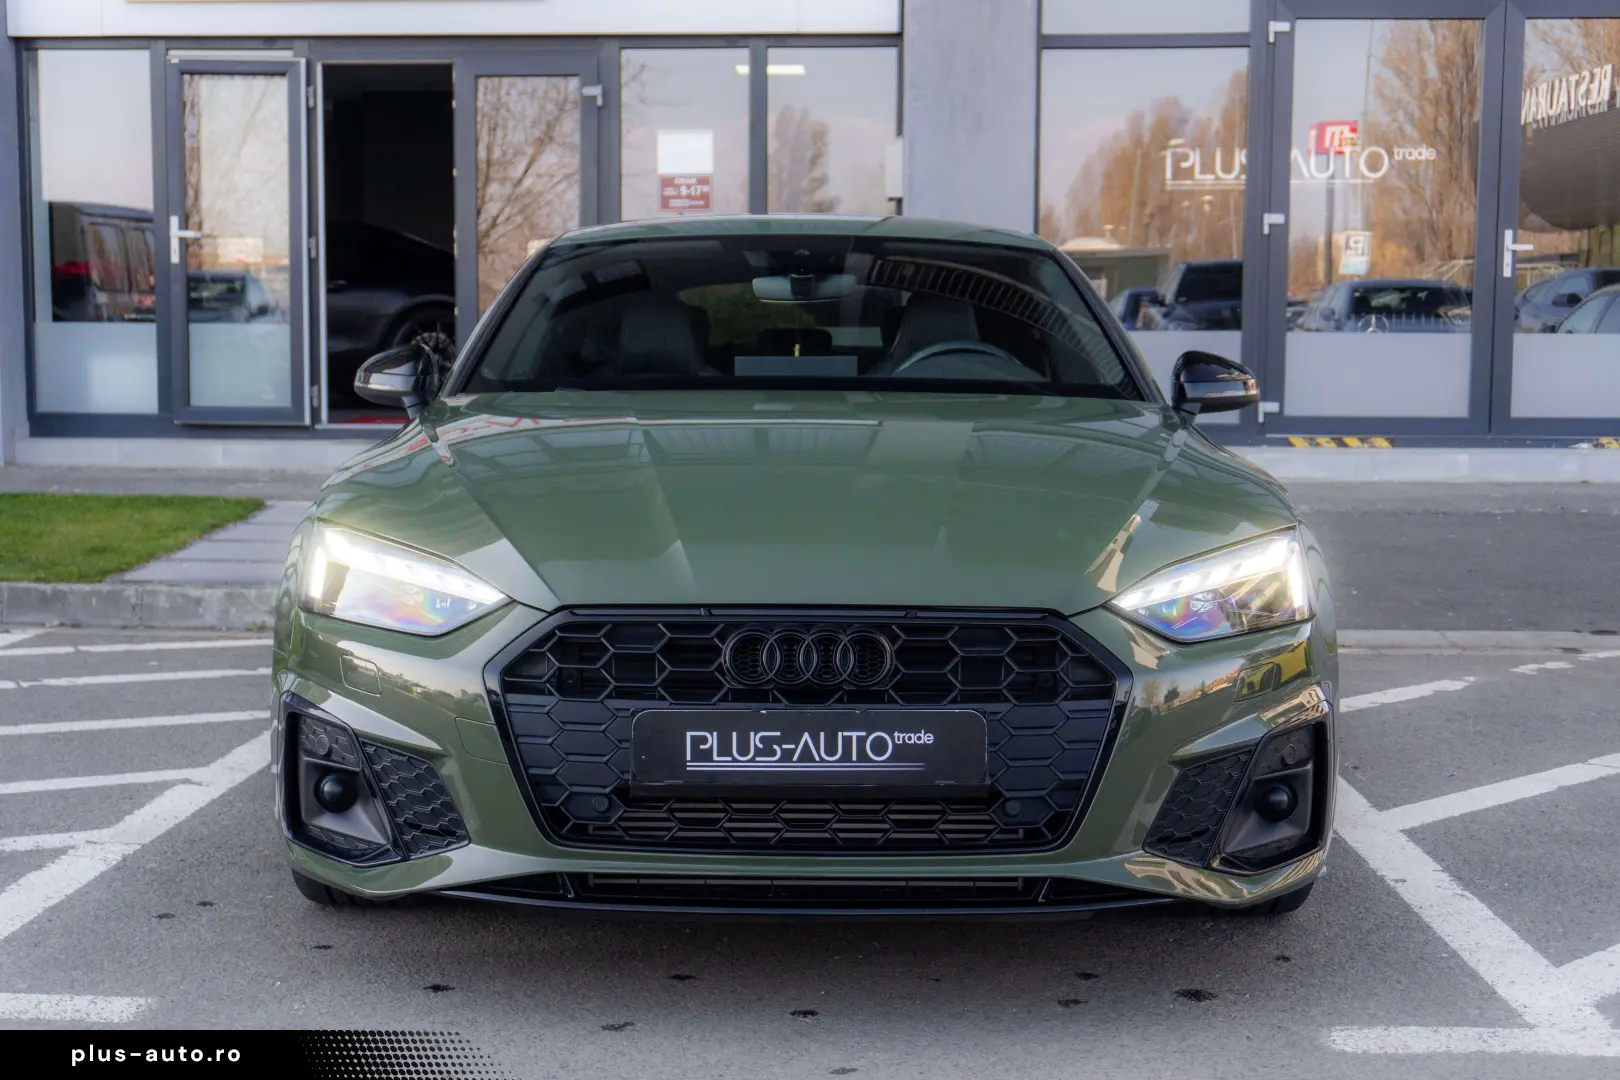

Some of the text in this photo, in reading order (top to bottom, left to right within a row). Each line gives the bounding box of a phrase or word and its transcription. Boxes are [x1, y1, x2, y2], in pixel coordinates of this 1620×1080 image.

[1393, 145, 1437, 161] trade
[686, 729, 934, 761] PLUS-AUTO trade
